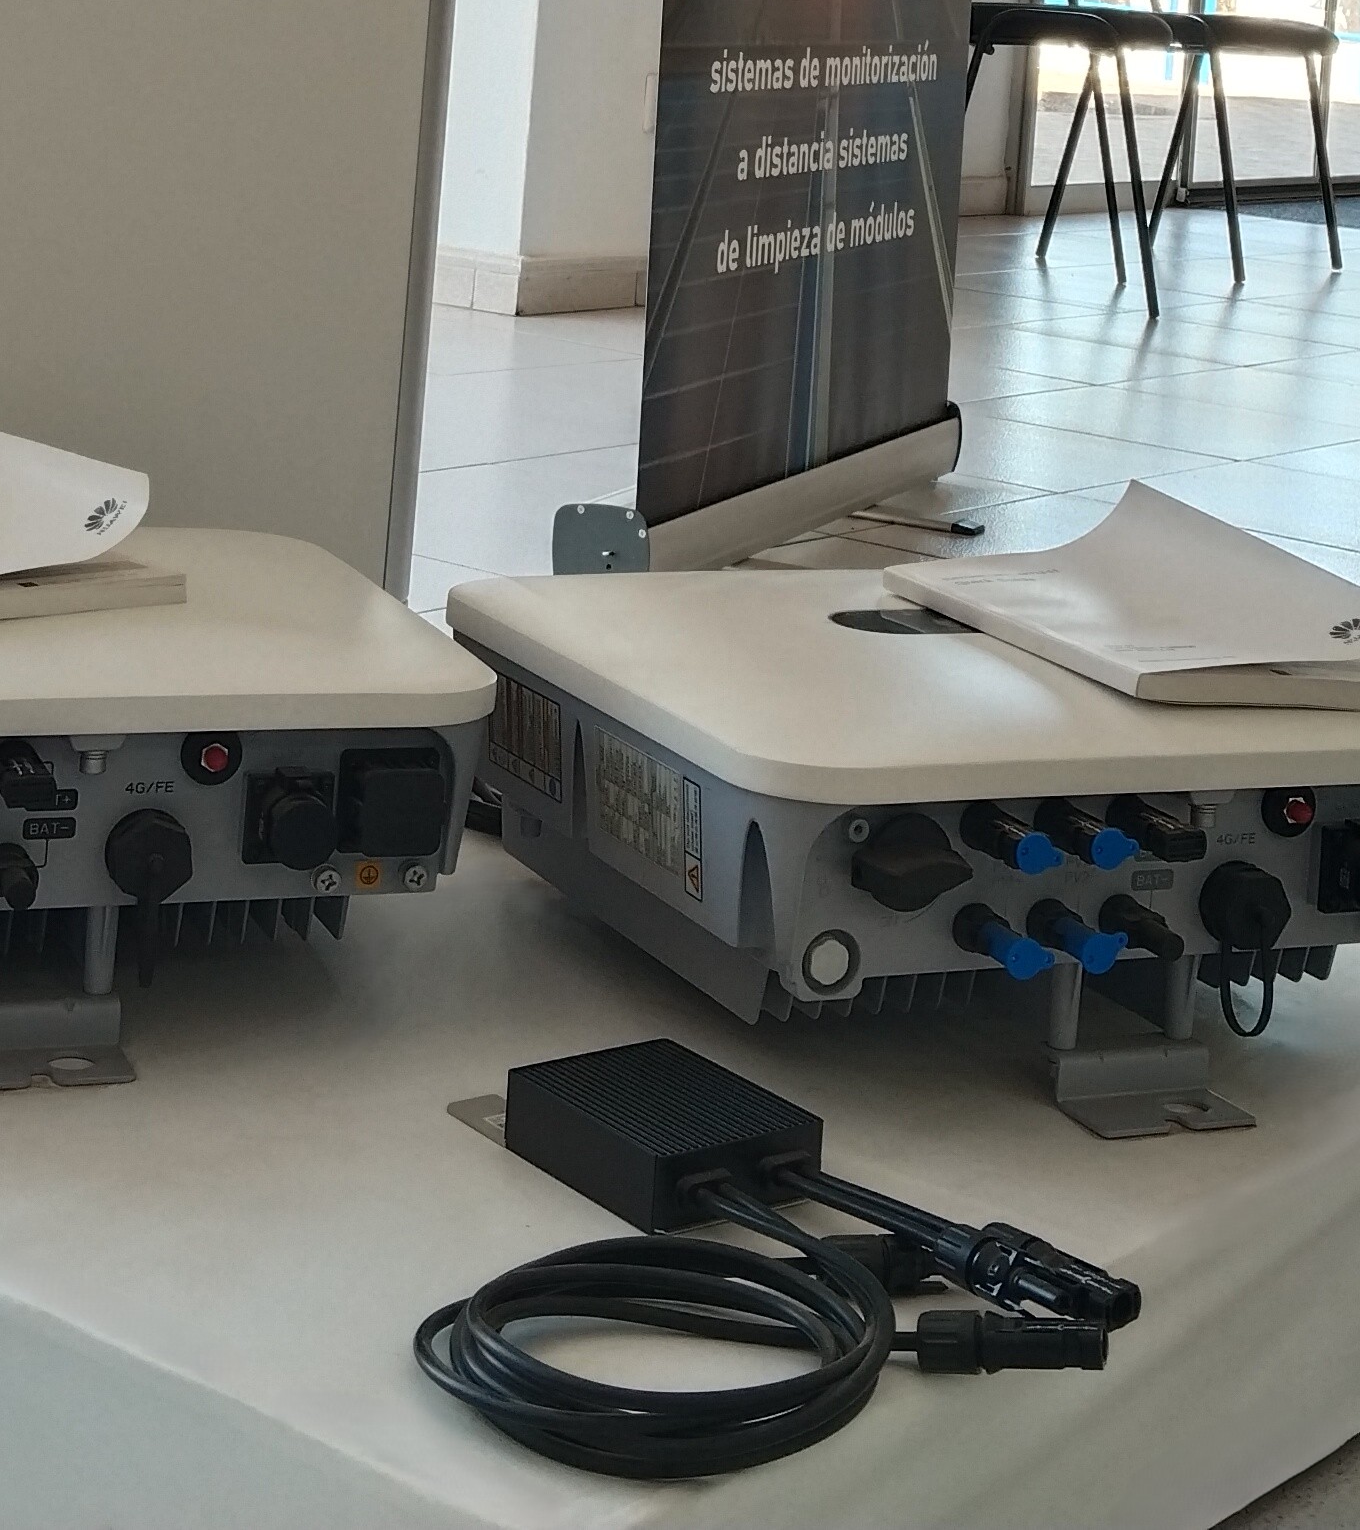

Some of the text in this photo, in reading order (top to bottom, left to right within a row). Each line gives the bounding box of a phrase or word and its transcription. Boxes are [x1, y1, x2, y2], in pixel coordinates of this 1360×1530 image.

[709, 40, 938, 94] sistemas de monitorización
[737, 127, 908, 181] a distancia sistemas
[716, 201, 915, 274] de limpieza de módulos
[125, 780, 175, 795] 4G/FE
[29, 822, 70, 835] BAT-
[1216, 832, 1257, 846] 4G/FE
[1136, 874, 1168, 887] BAT-
